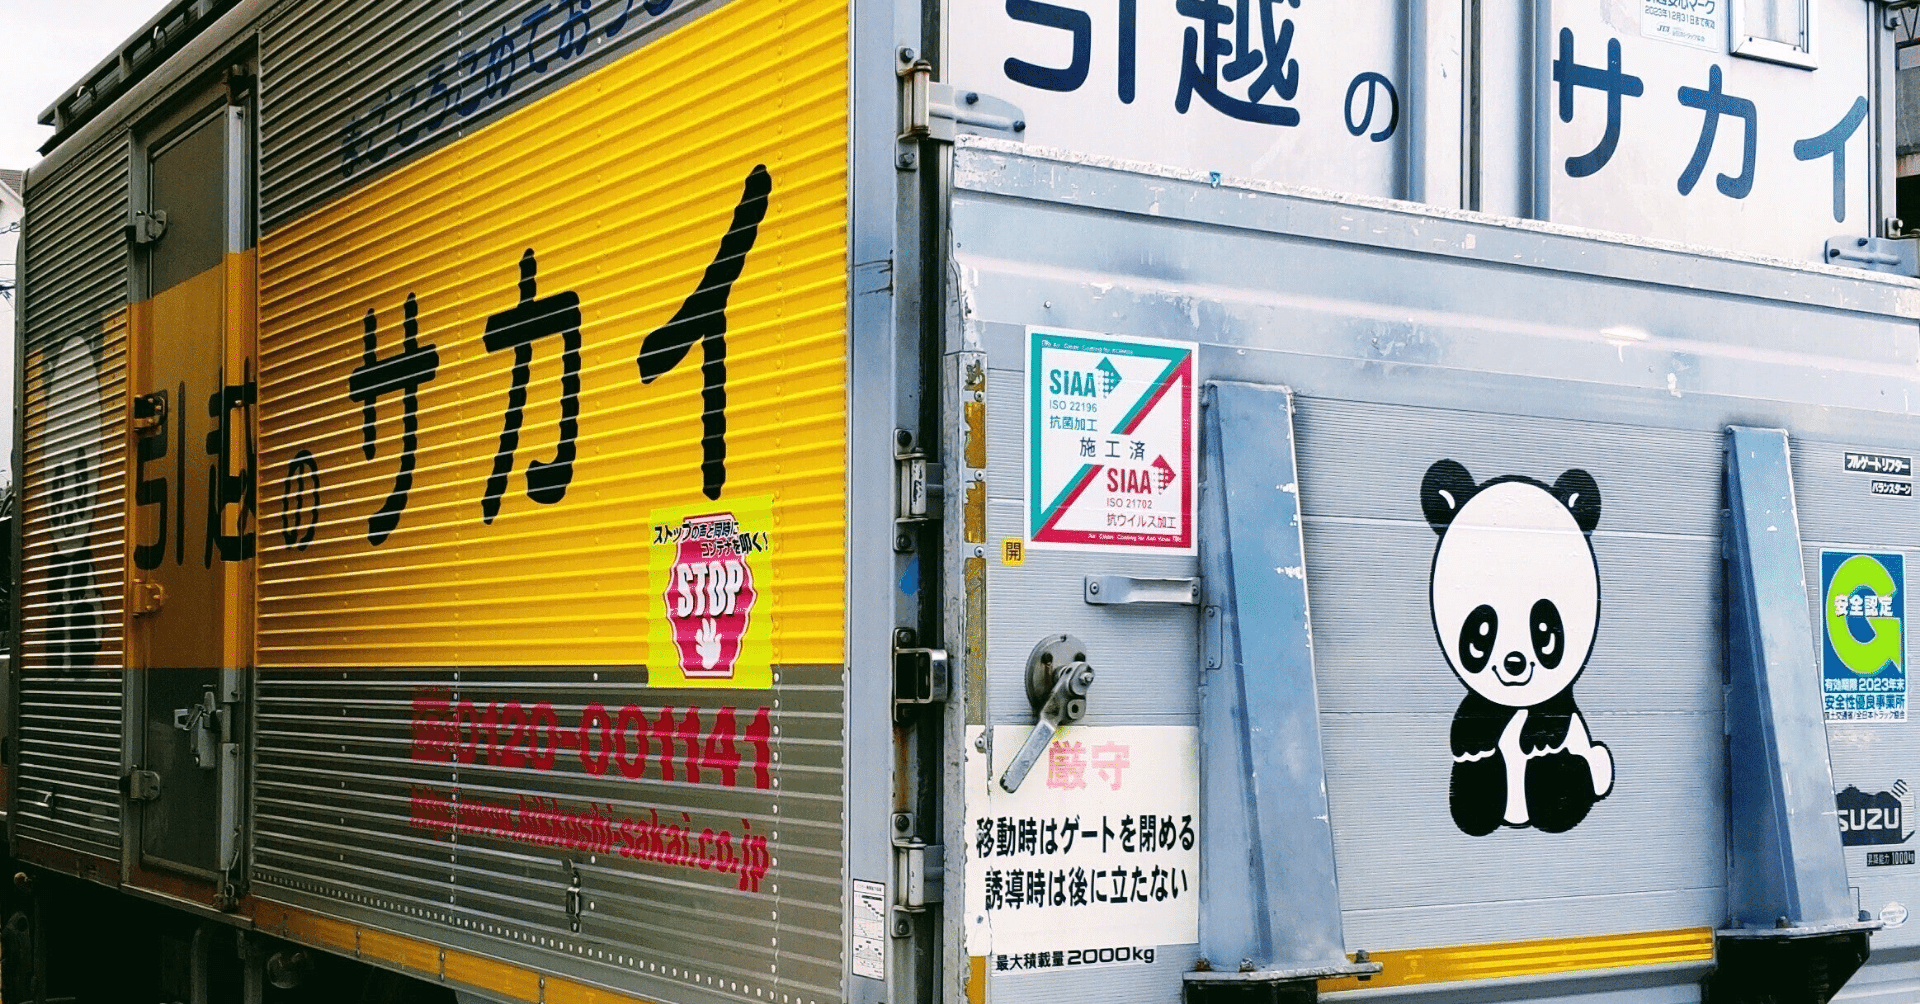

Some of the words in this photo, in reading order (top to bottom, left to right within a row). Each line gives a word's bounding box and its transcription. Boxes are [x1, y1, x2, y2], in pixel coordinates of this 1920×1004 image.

[1049, 400, 1067, 410] ISO
[1070, 402, 1097, 412] 22196
[1050, 415, 1098, 432] 抗菌加工
[1080, 437, 1145, 461] 施工済
[1847, 455, 1909, 472] フルゲートリフター
[1107, 468, 1151, 494] SIAA
[1872, 482, 1911, 495] バランスターン
[1107, 498, 1123, 508] ISO
[1126, 499, 1153, 509] 21702
[1107, 513, 1176, 529] 抗ウイルス加工
[1005, 541, 1021, 561] 開
[677, 560, 743, 617] STOP
[1834, 594, 1893, 617] 安全認定
[1824, 694, 1905, 710] 安全性優良事業所
[455, 699, 772, 790] 0120-001141
[1046, 741, 1131, 791] 厳守
[976, 814, 1195, 858] 移動時はゲートを閉める
[985, 865, 1188, 911] 誘導時は後に立たない
